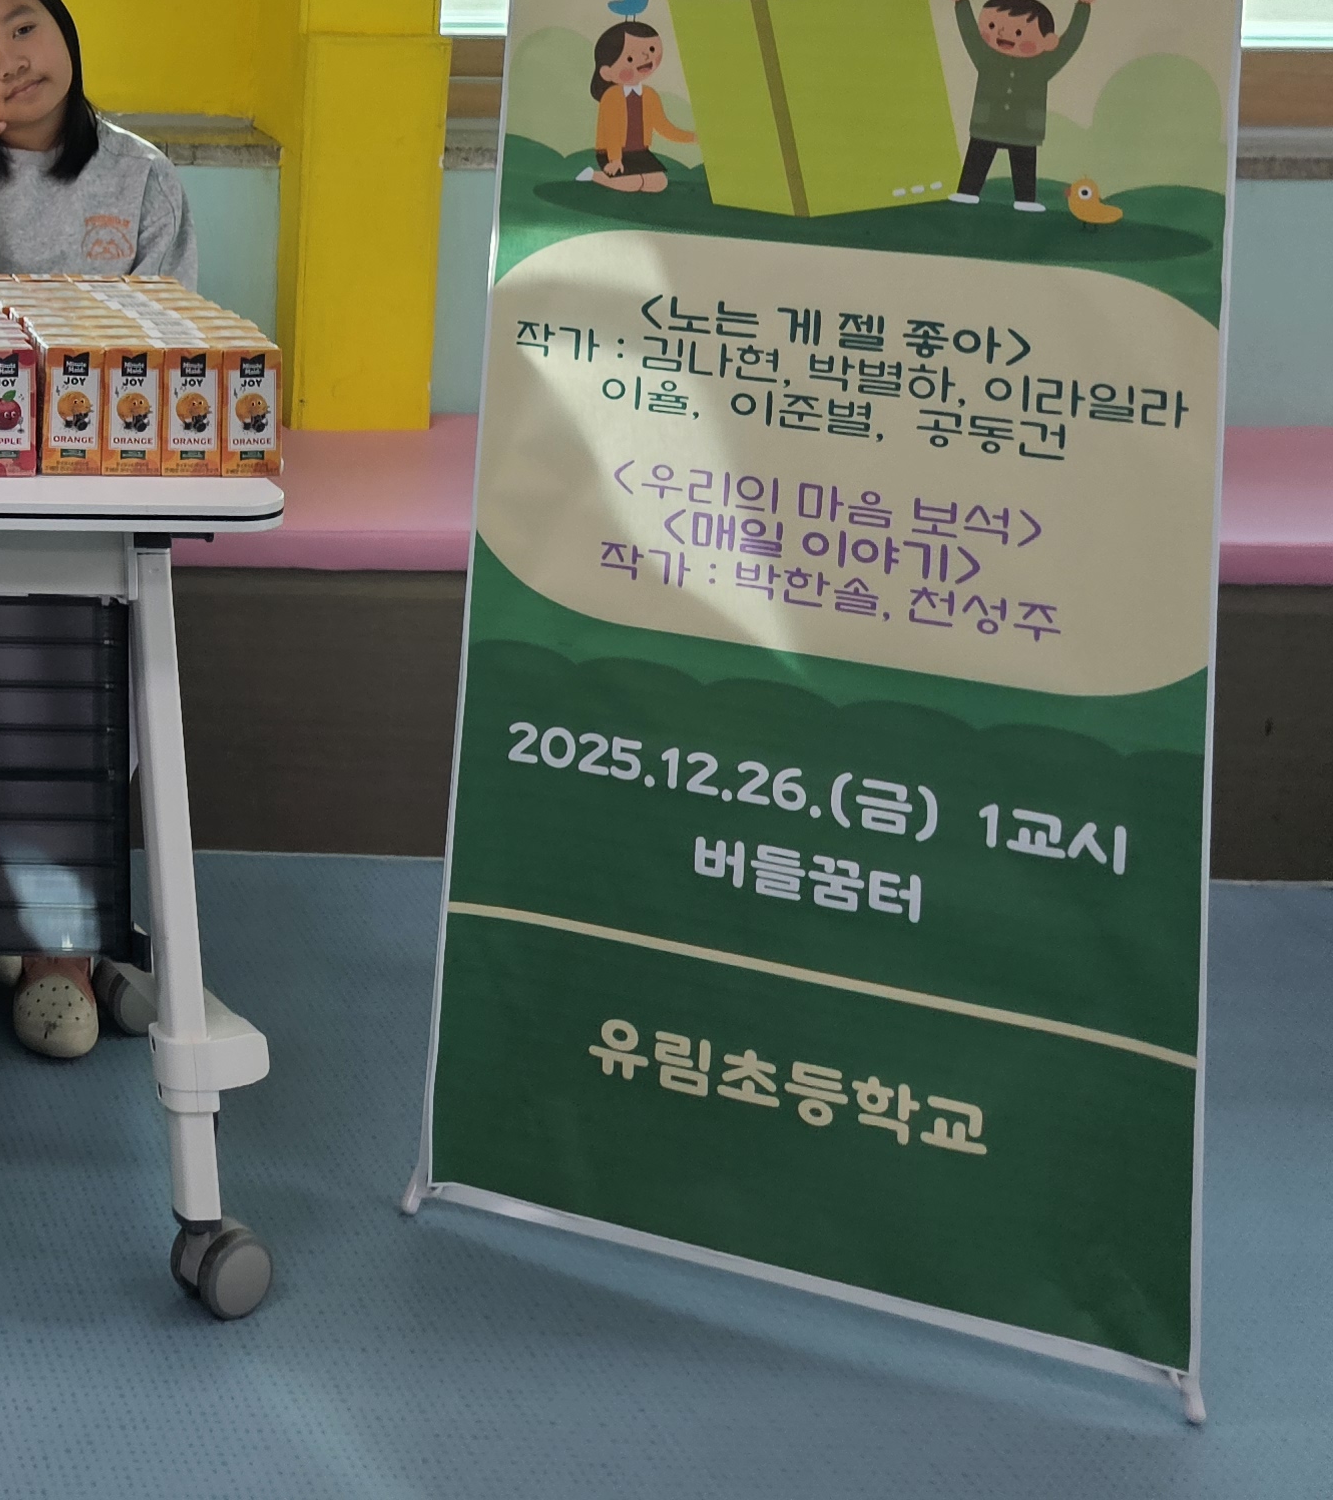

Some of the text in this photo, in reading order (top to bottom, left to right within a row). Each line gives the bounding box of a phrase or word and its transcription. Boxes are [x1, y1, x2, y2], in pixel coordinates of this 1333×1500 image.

[641, 294, 1032, 366] <노는 게 젤 좋아>
[63, 377, 86, 386] JOY
[122, 378, 145, 387] JOY
[181, 378, 204, 387] JOY
[240, 379, 263, 388] JOY
[516, 320, 601, 363] 작가
[808, 353, 966, 408] 박별하,
[984, 374, 1190, 429] 이라일라
[53, 436, 94, 444] ORANGE
[113, 437, 153, 445] ORANGE
[172, 437, 213, 445] ORANGE
[232, 437, 272, 446] ORANGE
[730, 391, 883, 443] 이준별,
[916, 409, 1066, 461] 공동건
[614, 460, 1042, 547] <우리의 마음 보석>
[664, 509, 981, 585] <매일 이야기>
[600, 541, 691, 590] 작가
[735, 559, 892, 622] 박한솔,
[909, 586, 1062, 642] 천성주
[508, 721, 1128, 876] 2025.12.26.(금) 1교시
[694, 836, 923, 923] 버들꿈터
[589, 1018, 988, 1156] 유림초등학교
